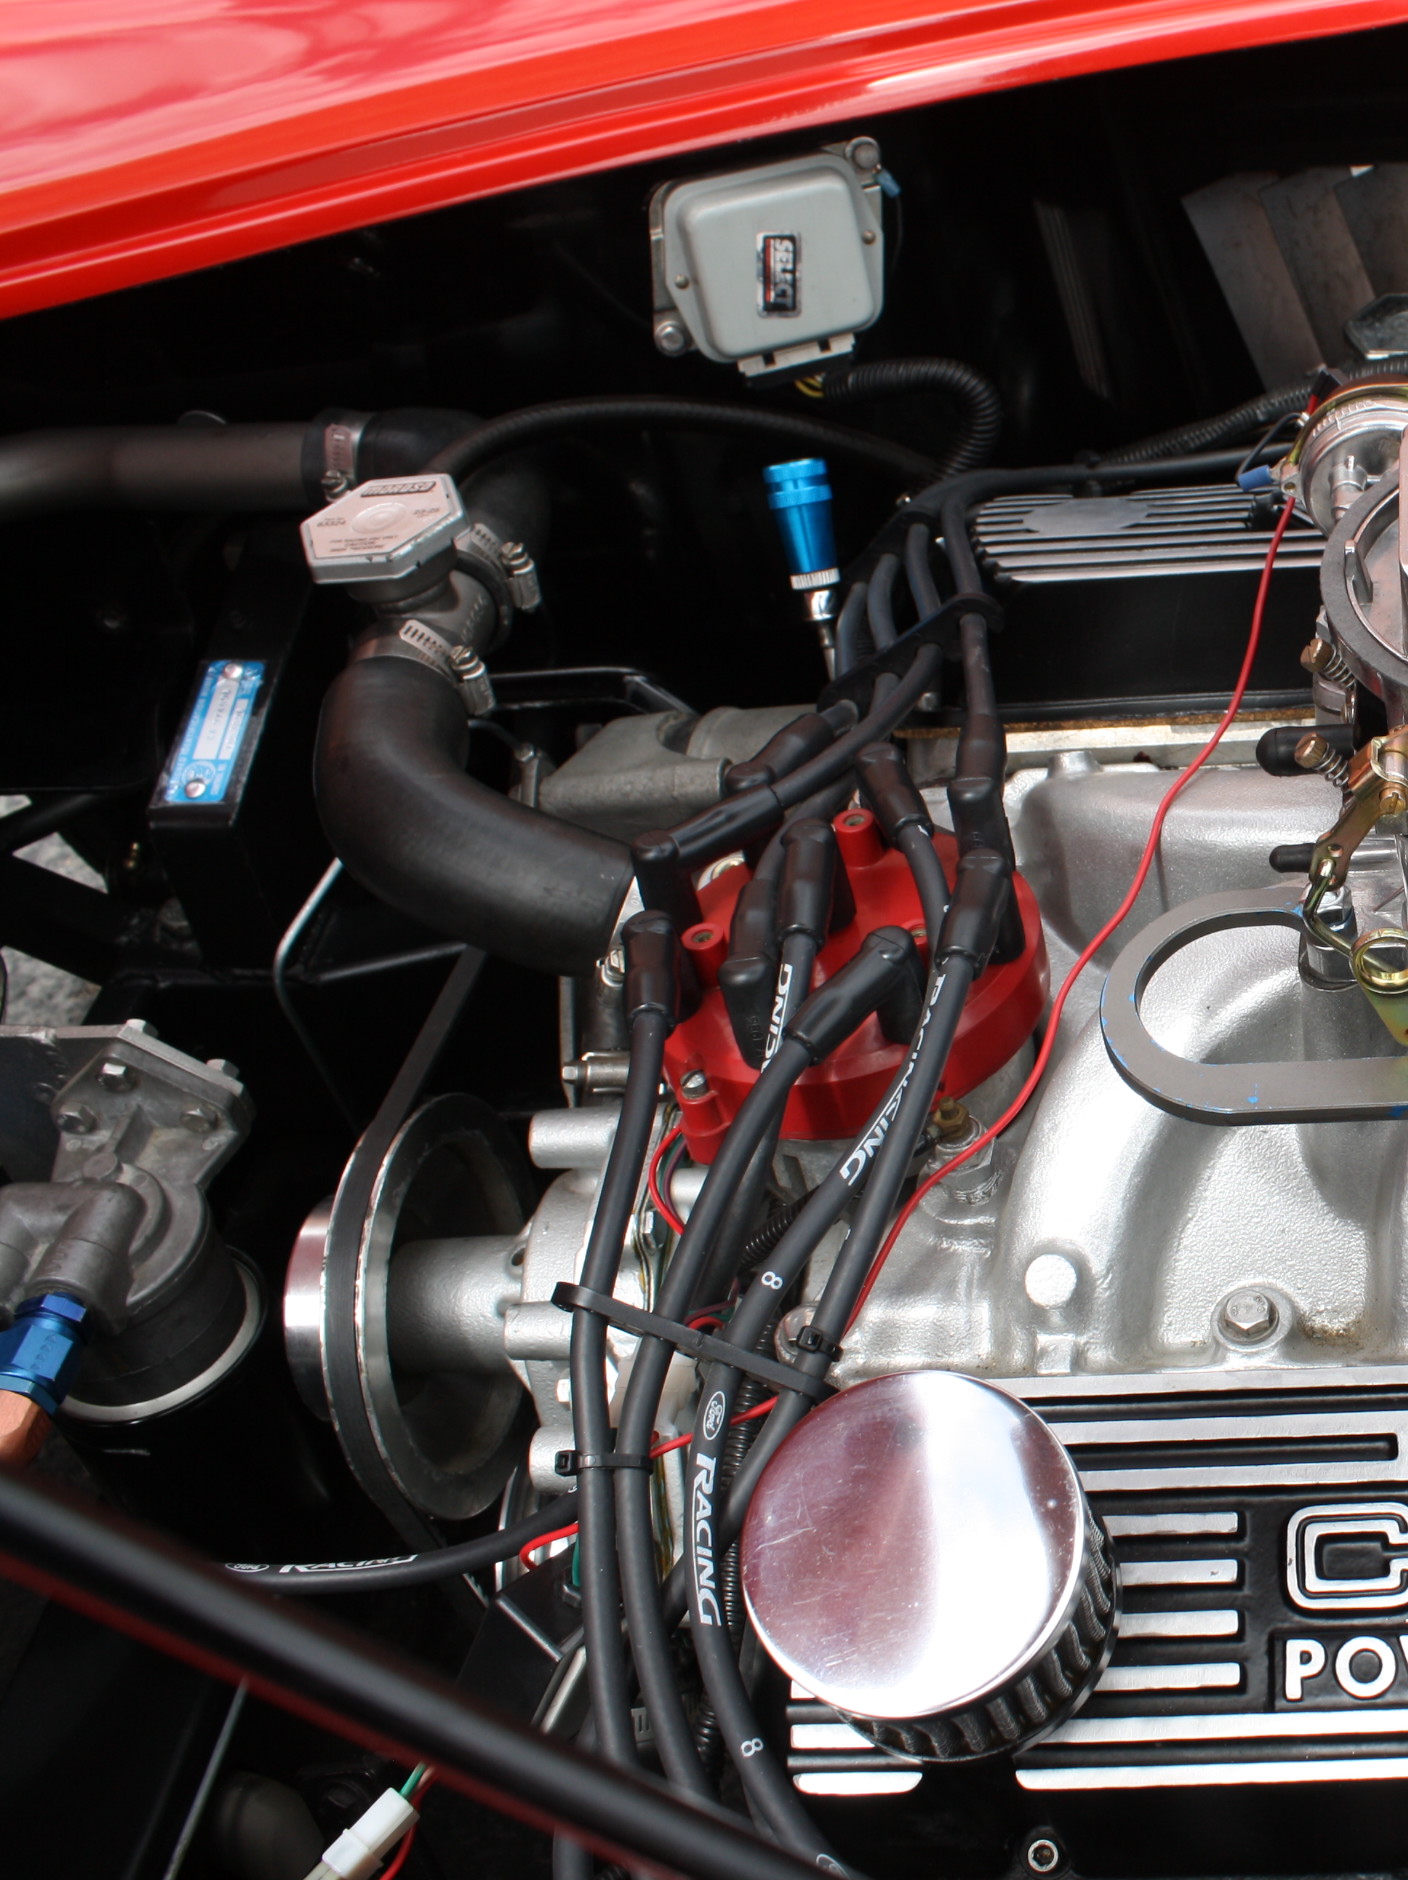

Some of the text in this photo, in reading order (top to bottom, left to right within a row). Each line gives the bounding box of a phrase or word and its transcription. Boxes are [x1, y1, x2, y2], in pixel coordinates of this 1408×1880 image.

[774, 239, 794, 308] SELECT
[761, 1271, 783, 1290] 8
[705, 1395, 726, 1435] Ford
[692, 1453, 723, 1627] RACING
[741, 1737, 764, 1757] 8
